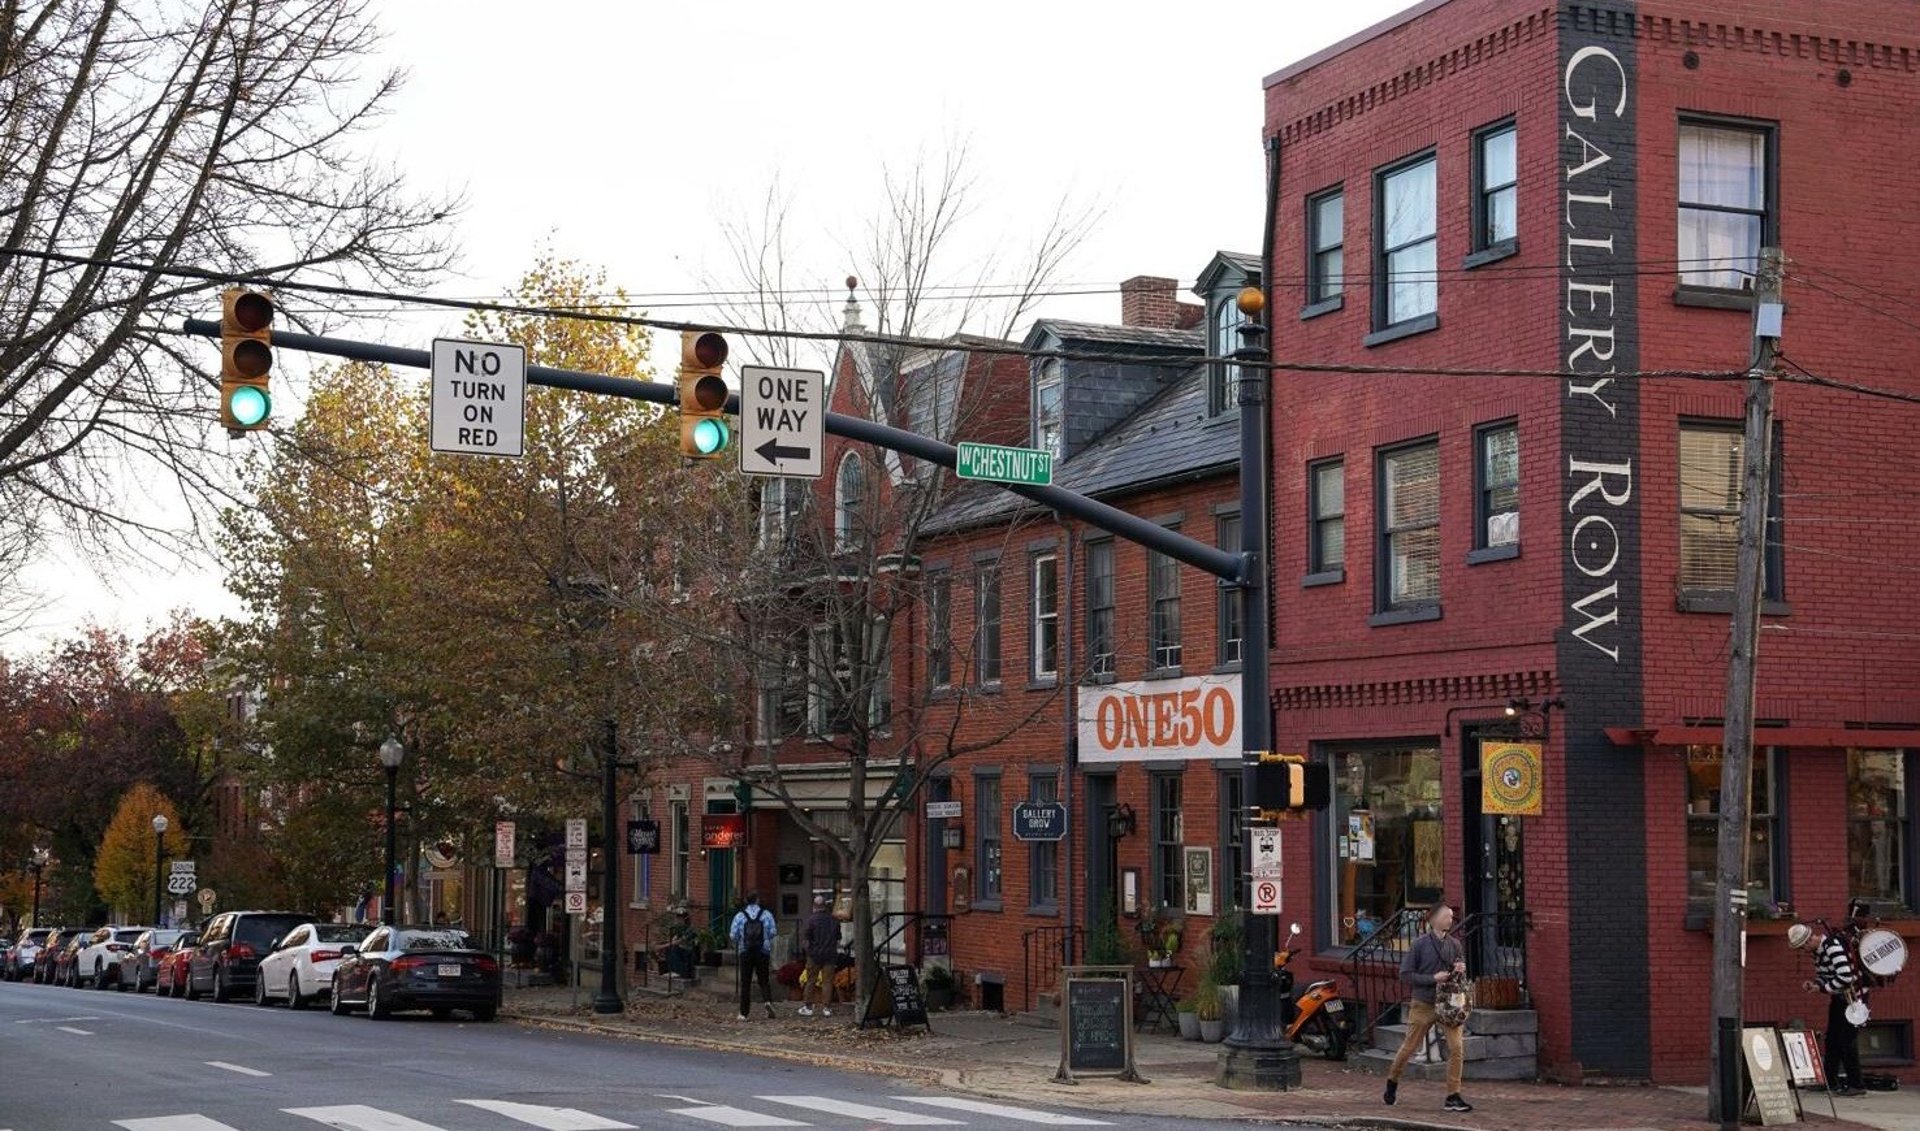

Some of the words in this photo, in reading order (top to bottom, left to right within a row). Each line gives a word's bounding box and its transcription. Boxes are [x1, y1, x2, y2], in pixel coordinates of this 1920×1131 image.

[1565, 46, 1627, 418] GALLERY
[455, 349, 500, 376] NO
[451, 380, 505, 401] TURN
[758, 376, 809, 403] ONE
[464, 405, 493, 423] ON
[756, 407, 808, 433] WAY
[458, 427, 498, 447] RED
[961, 446, 972, 465] W
[972, 447, 1037, 480] CHESTNUT
[1038, 454, 1049, 473] ST
[1568, 454, 1631, 662] ROW
[1097, 687, 1235, 750] ONE50
[171, 877, 195, 889] 222
